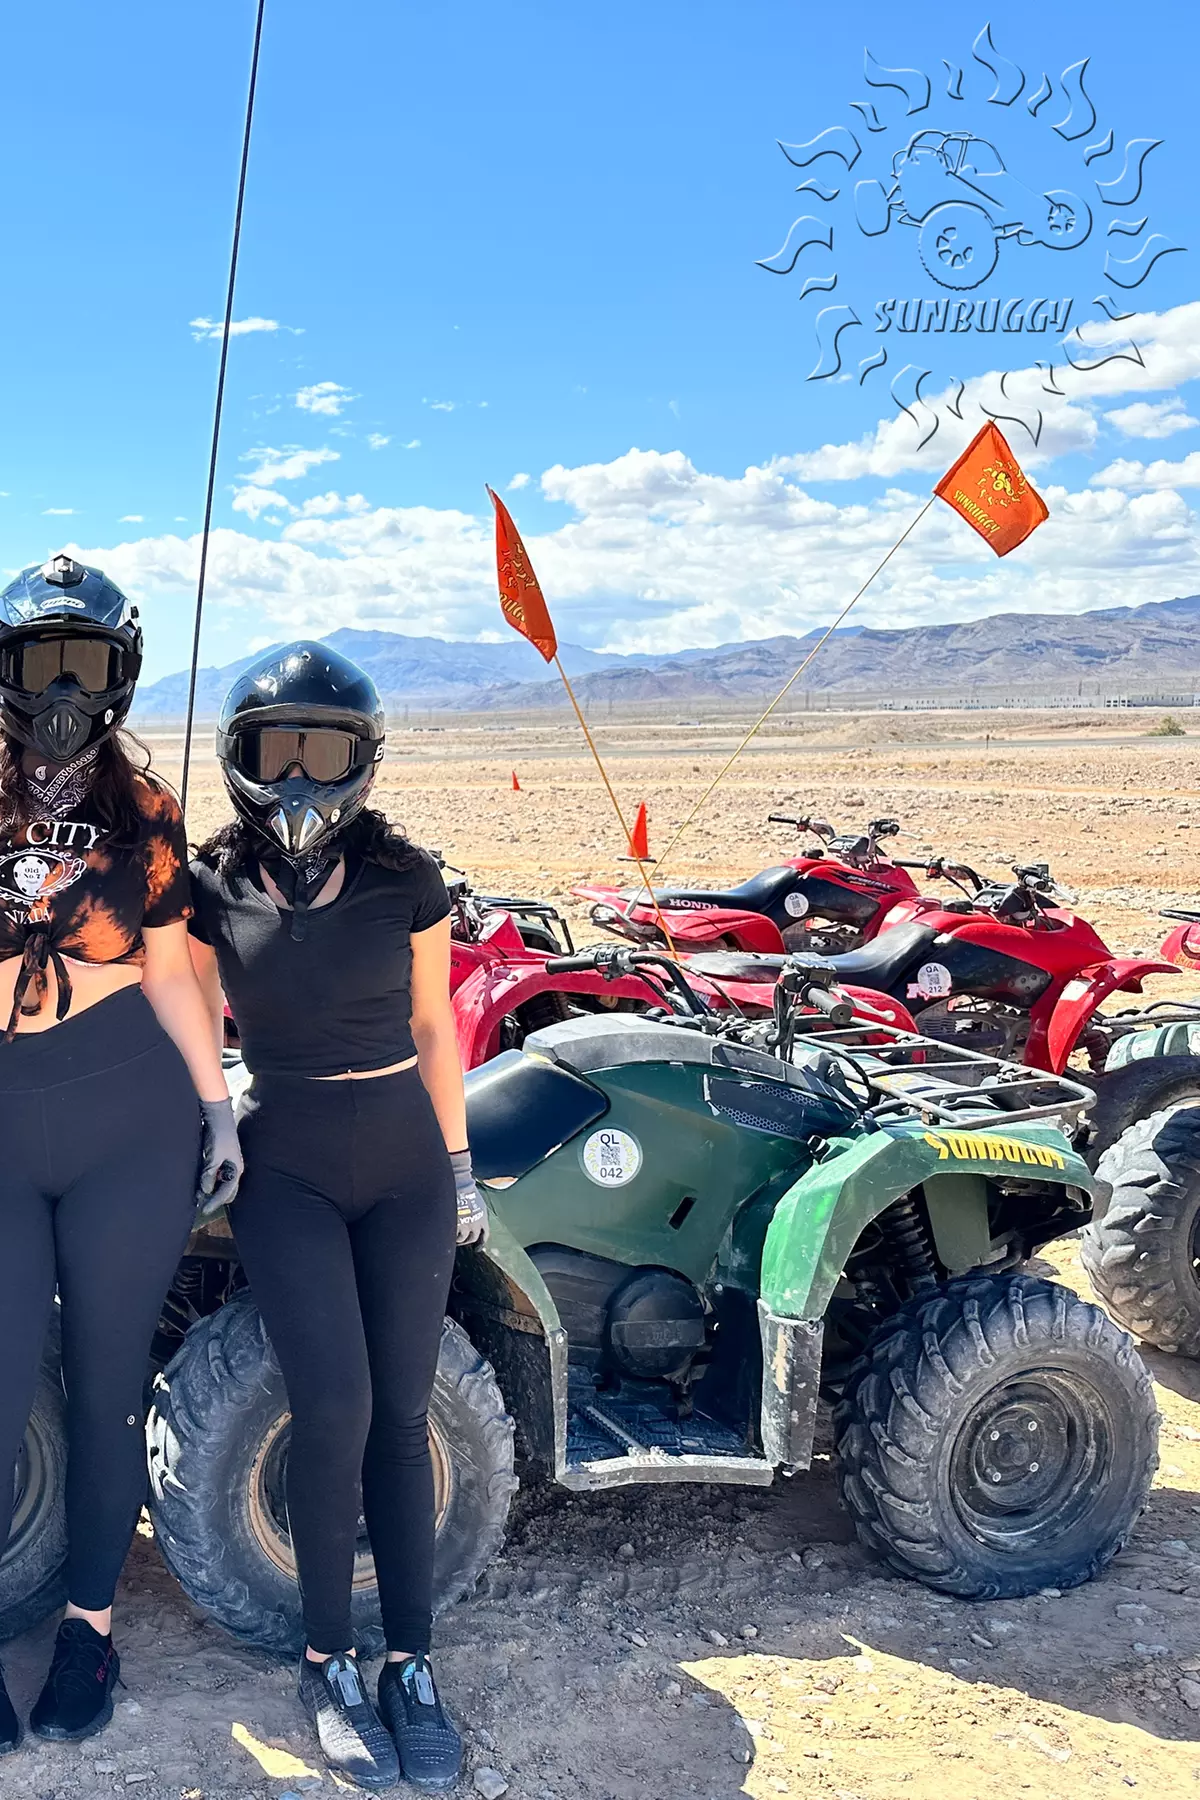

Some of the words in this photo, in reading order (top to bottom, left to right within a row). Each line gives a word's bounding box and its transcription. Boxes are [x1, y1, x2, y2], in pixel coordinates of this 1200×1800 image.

[26, 820, 109, 850] CITY
[669, 898, 720, 910] HONDA
[929, 985, 942, 993] 212
[600, 1133, 620, 1148] QL
[600, 1167, 623, 1179] 042
